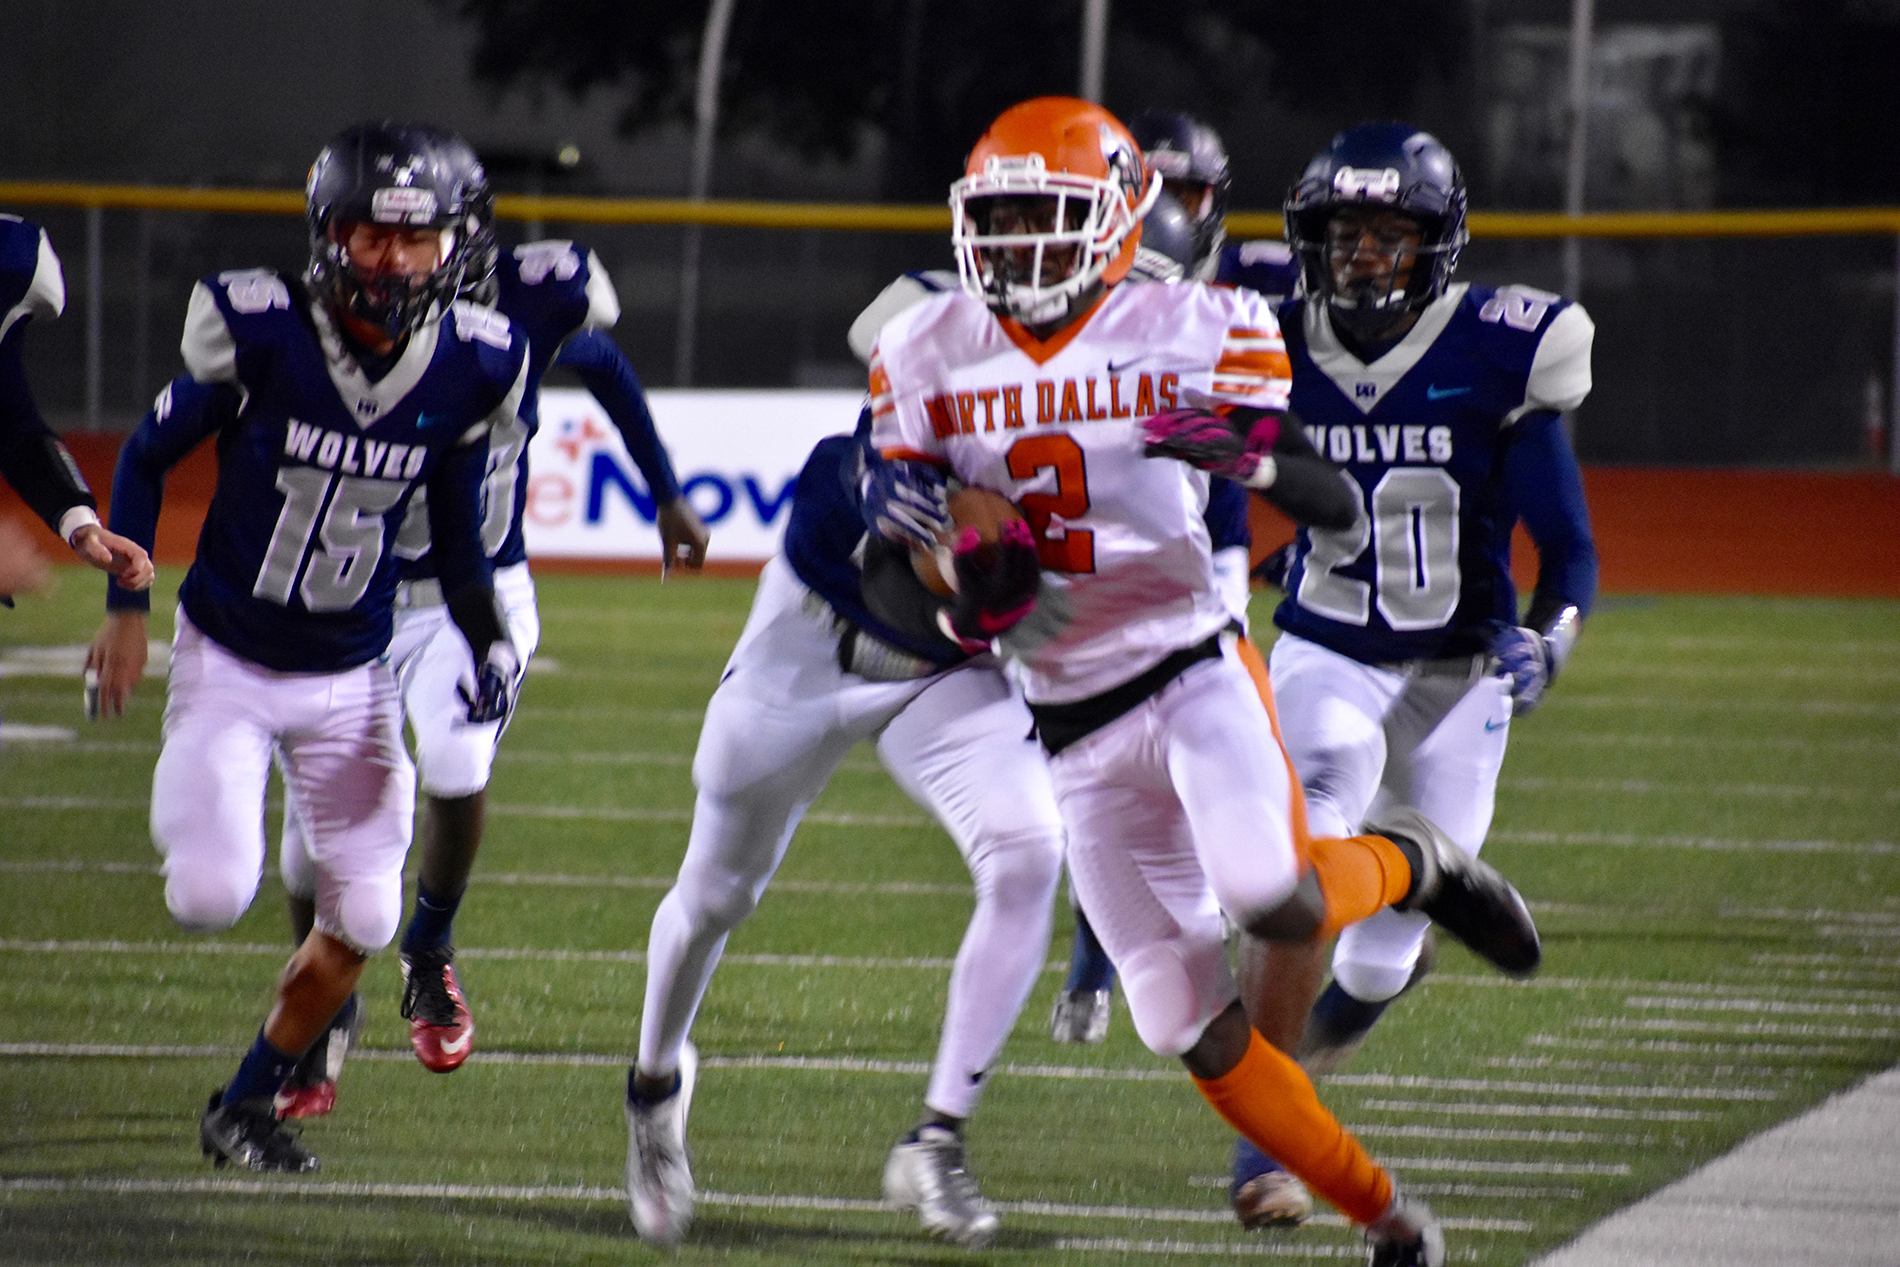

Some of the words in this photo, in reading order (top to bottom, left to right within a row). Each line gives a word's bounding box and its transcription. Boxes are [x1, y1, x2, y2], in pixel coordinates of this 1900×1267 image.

[1036, 372, 1179, 424] DALLAS
[251, 466, 412, 613] 15
[1005, 433, 1096, 574] 2
[1296, 466, 1462, 632] 20
